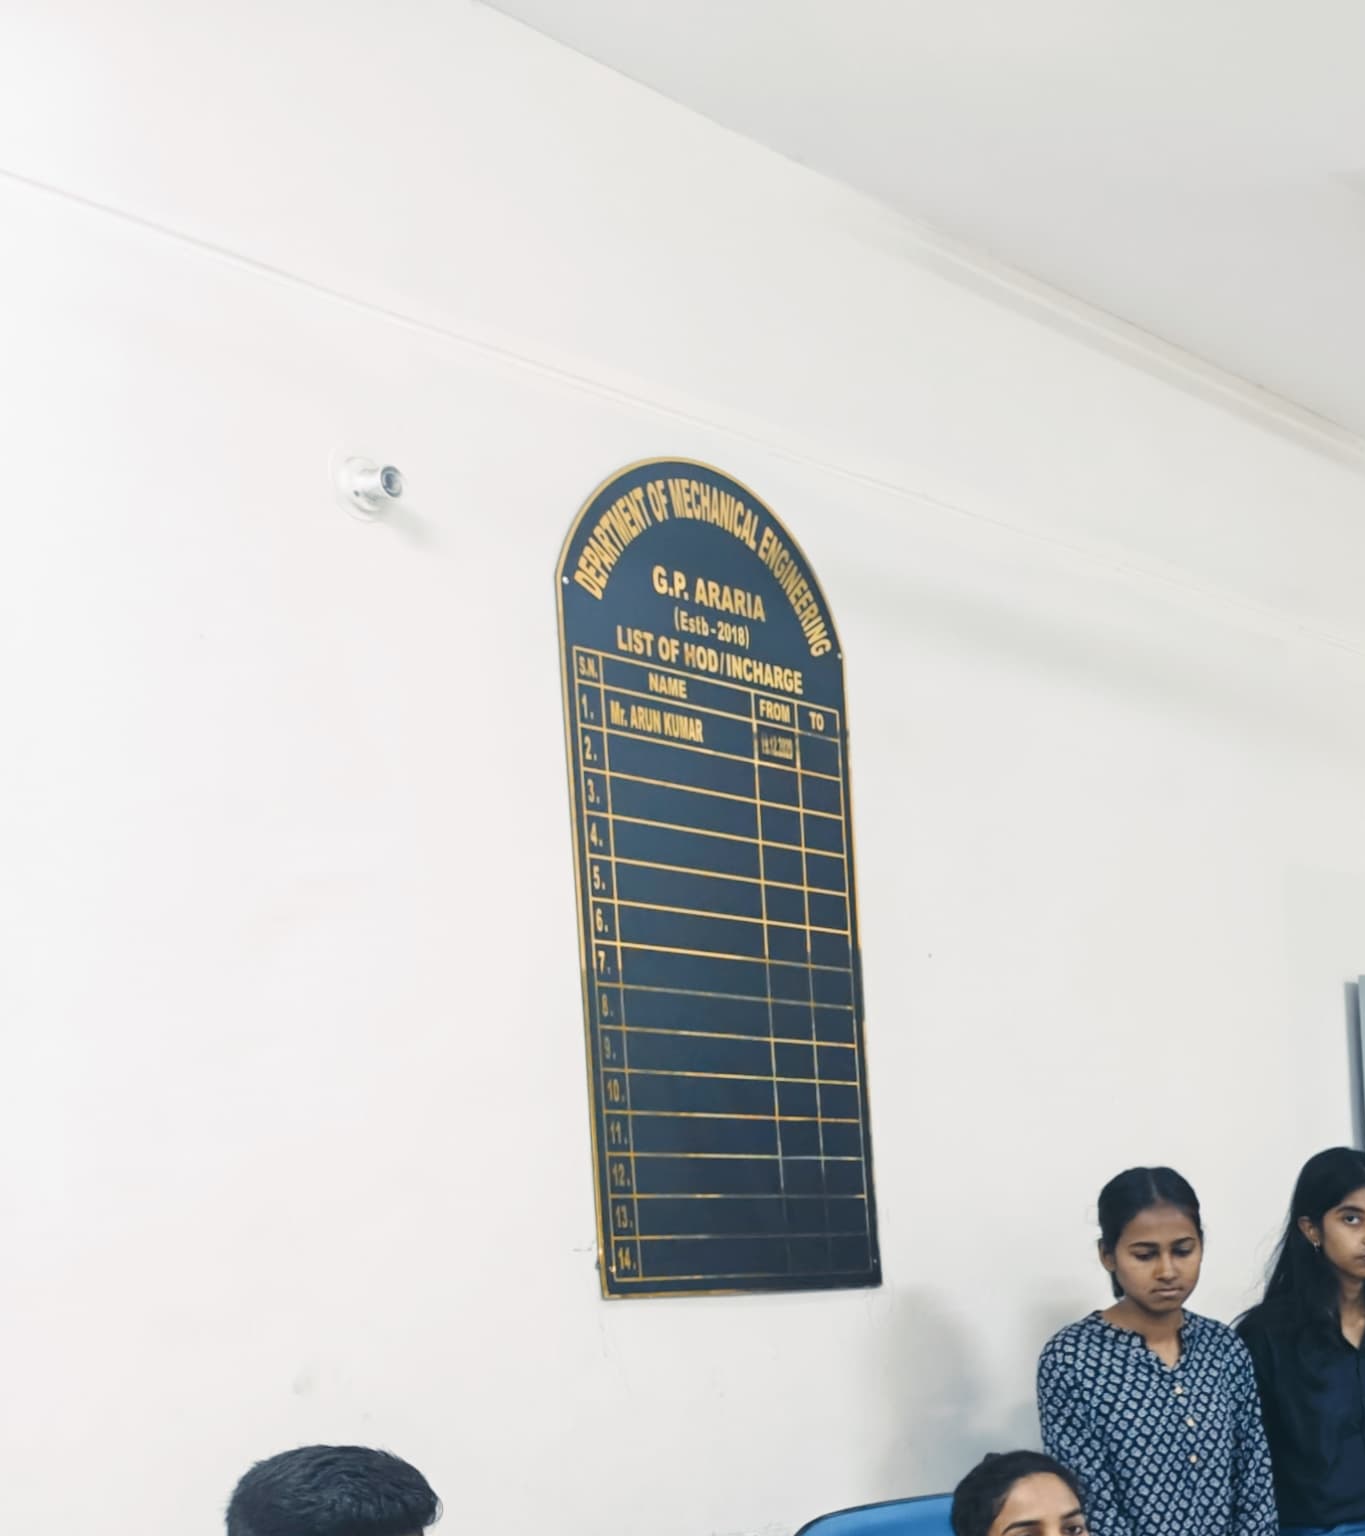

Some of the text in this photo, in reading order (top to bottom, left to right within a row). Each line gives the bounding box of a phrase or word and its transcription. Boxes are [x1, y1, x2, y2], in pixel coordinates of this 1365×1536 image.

[574, 478, 833, 659] DEPARTMENT OF MECHANICAL ENGINEERING
[652, 565, 766, 622] G.P. ARARIA
[616, 625, 654, 657] LIST
[657, 634, 680, 663] OF
[578, 655, 826, 732] S.N. NAME FROM TO
[580, 692, 595, 721] 1.
[608, 700, 628, 727] Mr.
[629, 705, 661, 734] ARUN
[663, 711, 705, 744] KUMAR
[584, 736, 598, 762] 2.
[587, 779, 601, 804] 3.
[590, 822, 604, 848] 4.
[592, 865, 606, 891] 5.
[595, 910, 609, 933] 6.
[597, 950, 612, 975] 7.
[601, 993, 615, 1018] 8.
[603, 1036, 617, 1060] 9.
[606, 1079, 625, 1103] 10.
[610, 1124, 629, 1145] 11.
[612, 1164, 632, 1188] 12.
[615, 1205, 634, 1229] 13.
[617, 1246, 638, 1271] 14.
